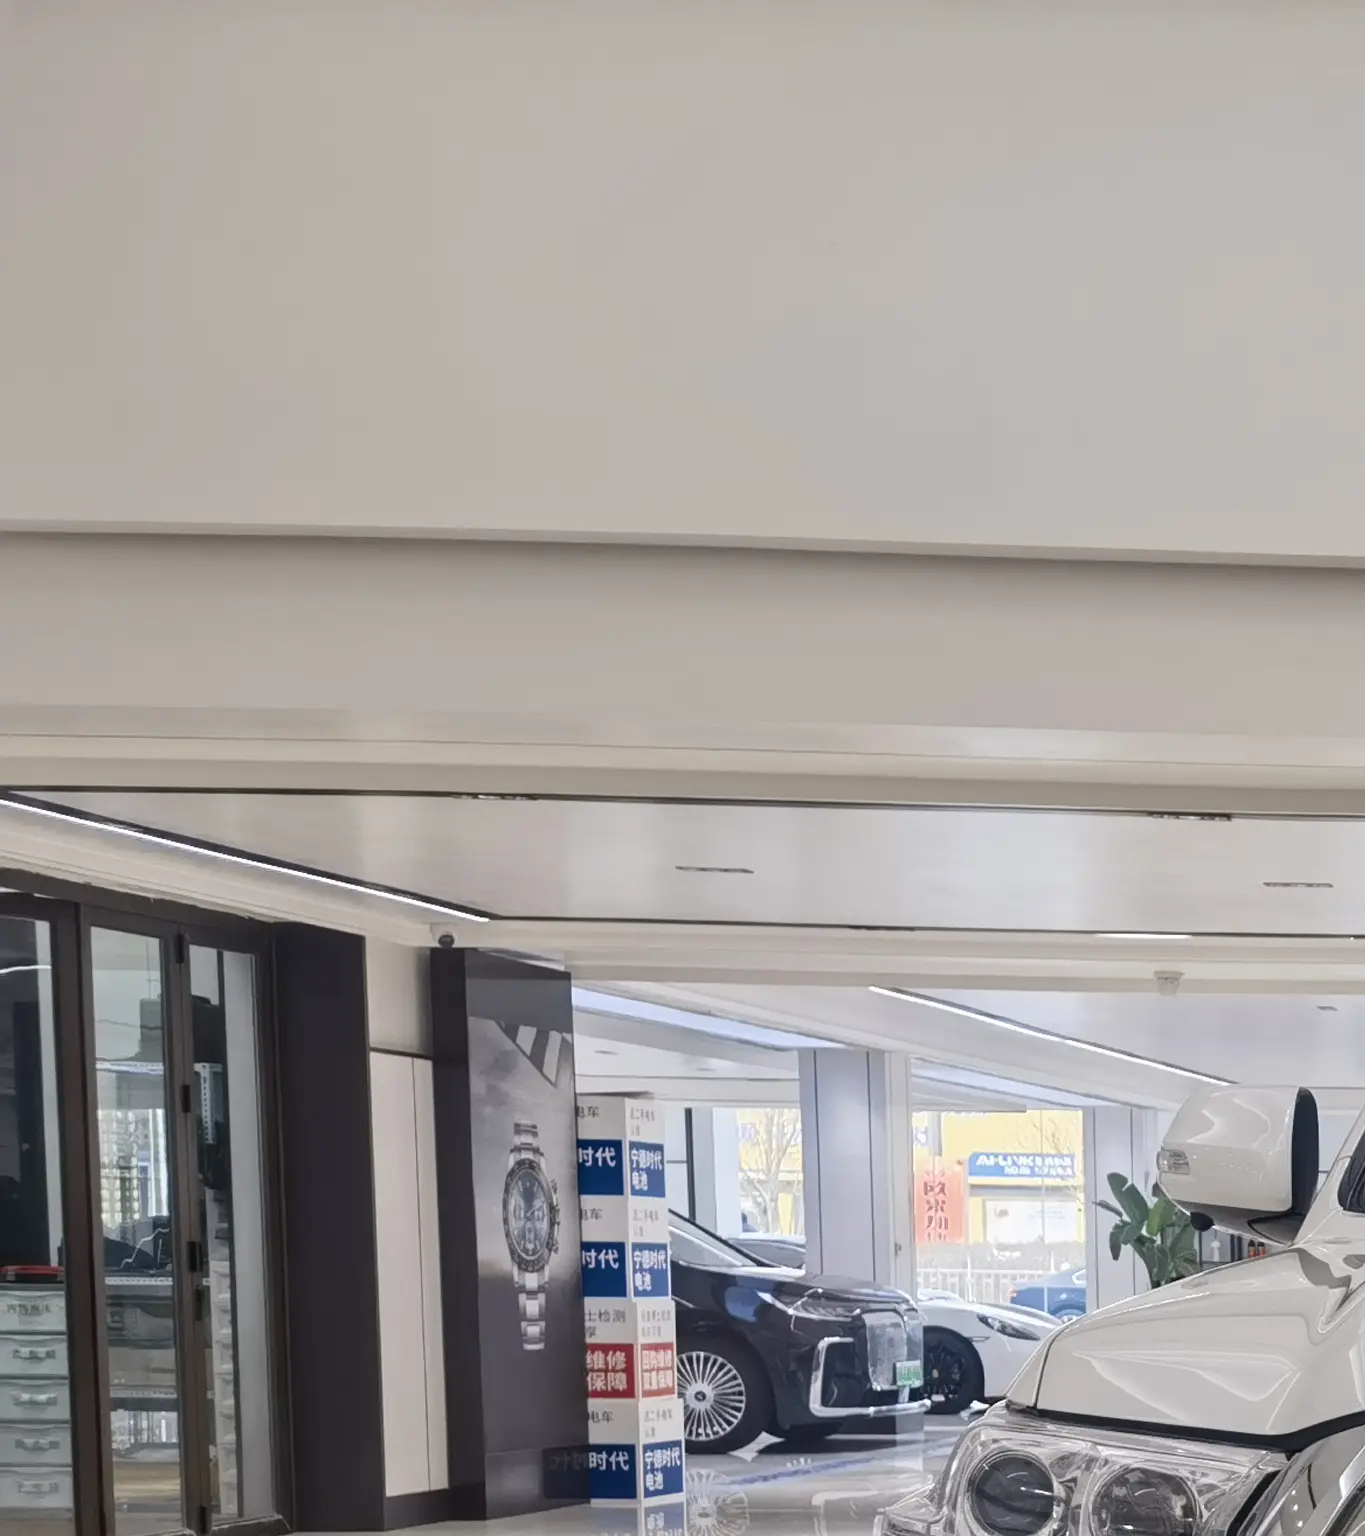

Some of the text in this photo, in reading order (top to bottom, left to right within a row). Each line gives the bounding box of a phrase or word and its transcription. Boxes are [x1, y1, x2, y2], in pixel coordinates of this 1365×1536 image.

[578, 1146, 616, 1167] 时代
[631, 1148, 662, 1170] 宁德时代
[632, 1171, 648, 1191] 电池
[633, 1249, 666, 1269] 宁德时代
[634, 1271, 652, 1291] 电池
[587, 1372, 627, 1391] 保障
[588, 1451, 629, 1471] 时代
[644, 1447, 681, 1470] 宁德时代
[646, 1471, 664, 1491] 电池
